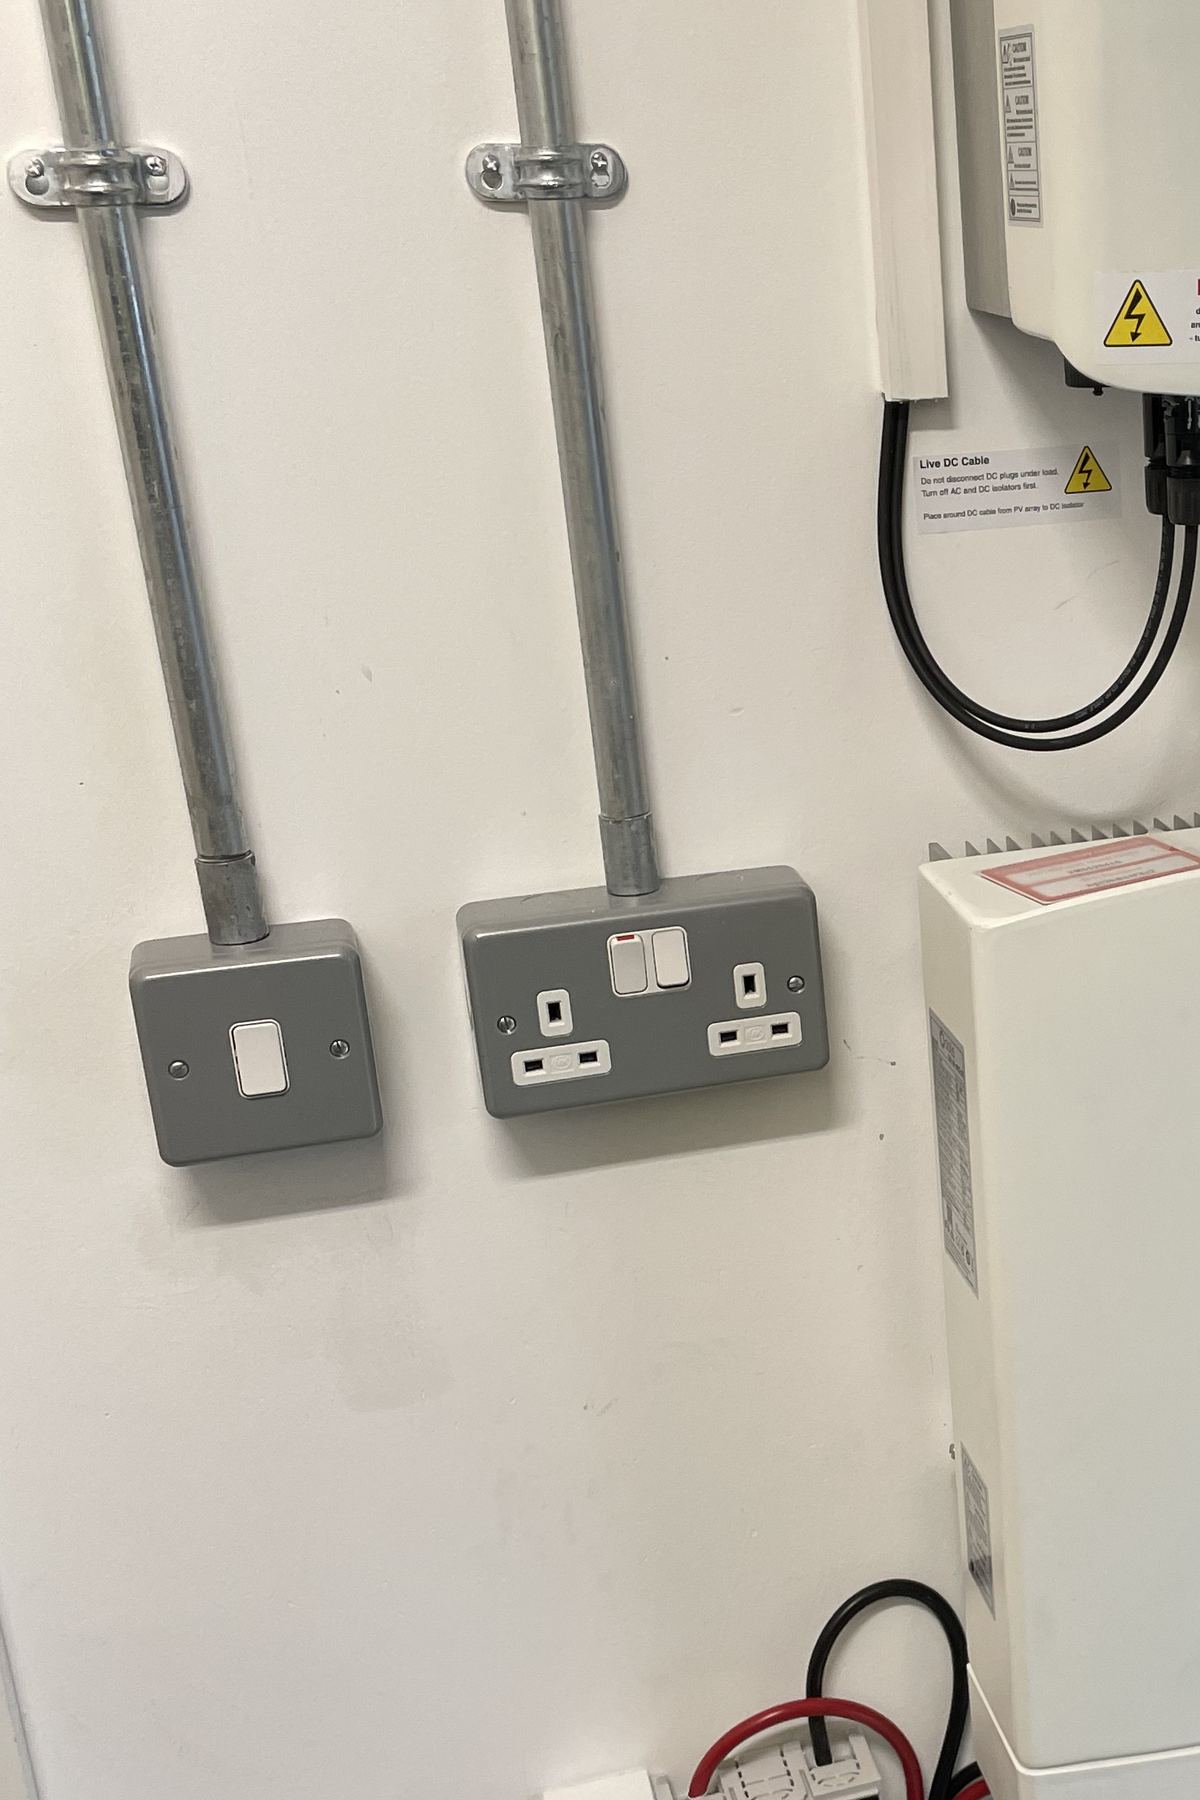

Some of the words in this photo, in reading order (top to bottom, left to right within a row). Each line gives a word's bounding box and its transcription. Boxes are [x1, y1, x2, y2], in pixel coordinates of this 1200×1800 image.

[919, 459, 941, 469] Live
[943, 458, 959, 468] DC
[961, 456, 990, 466] Cable
[921, 477, 931, 486] Do
[933, 476, 945, 484] not
[946, 473, 985, 484] disconnect
[986, 471, 998, 481] DC
[999, 470, 1019, 481] plugs
[1020, 469, 1040, 478] under
[921, 489, 937, 498] Turn
[939, 488, 949, 497] off
[950, 486, 962, 495] AC
[964, 485, 977, 494] and
[978, 484, 990, 493] DC
[992, 482, 1022, 492] isolators
[923, 511, 942, 520] Place
[943, 510, 966, 519] around
[967, 509, 978, 517] DC
[979, 507, 997, 516] cable
[997, 506, 1012, 514] from
[1013, 505, 1023, 513] PV
[1024, 504, 1041, 513] array
[1042, 503, 1048, 511] to
[1050, 502, 1060, 510] DC
